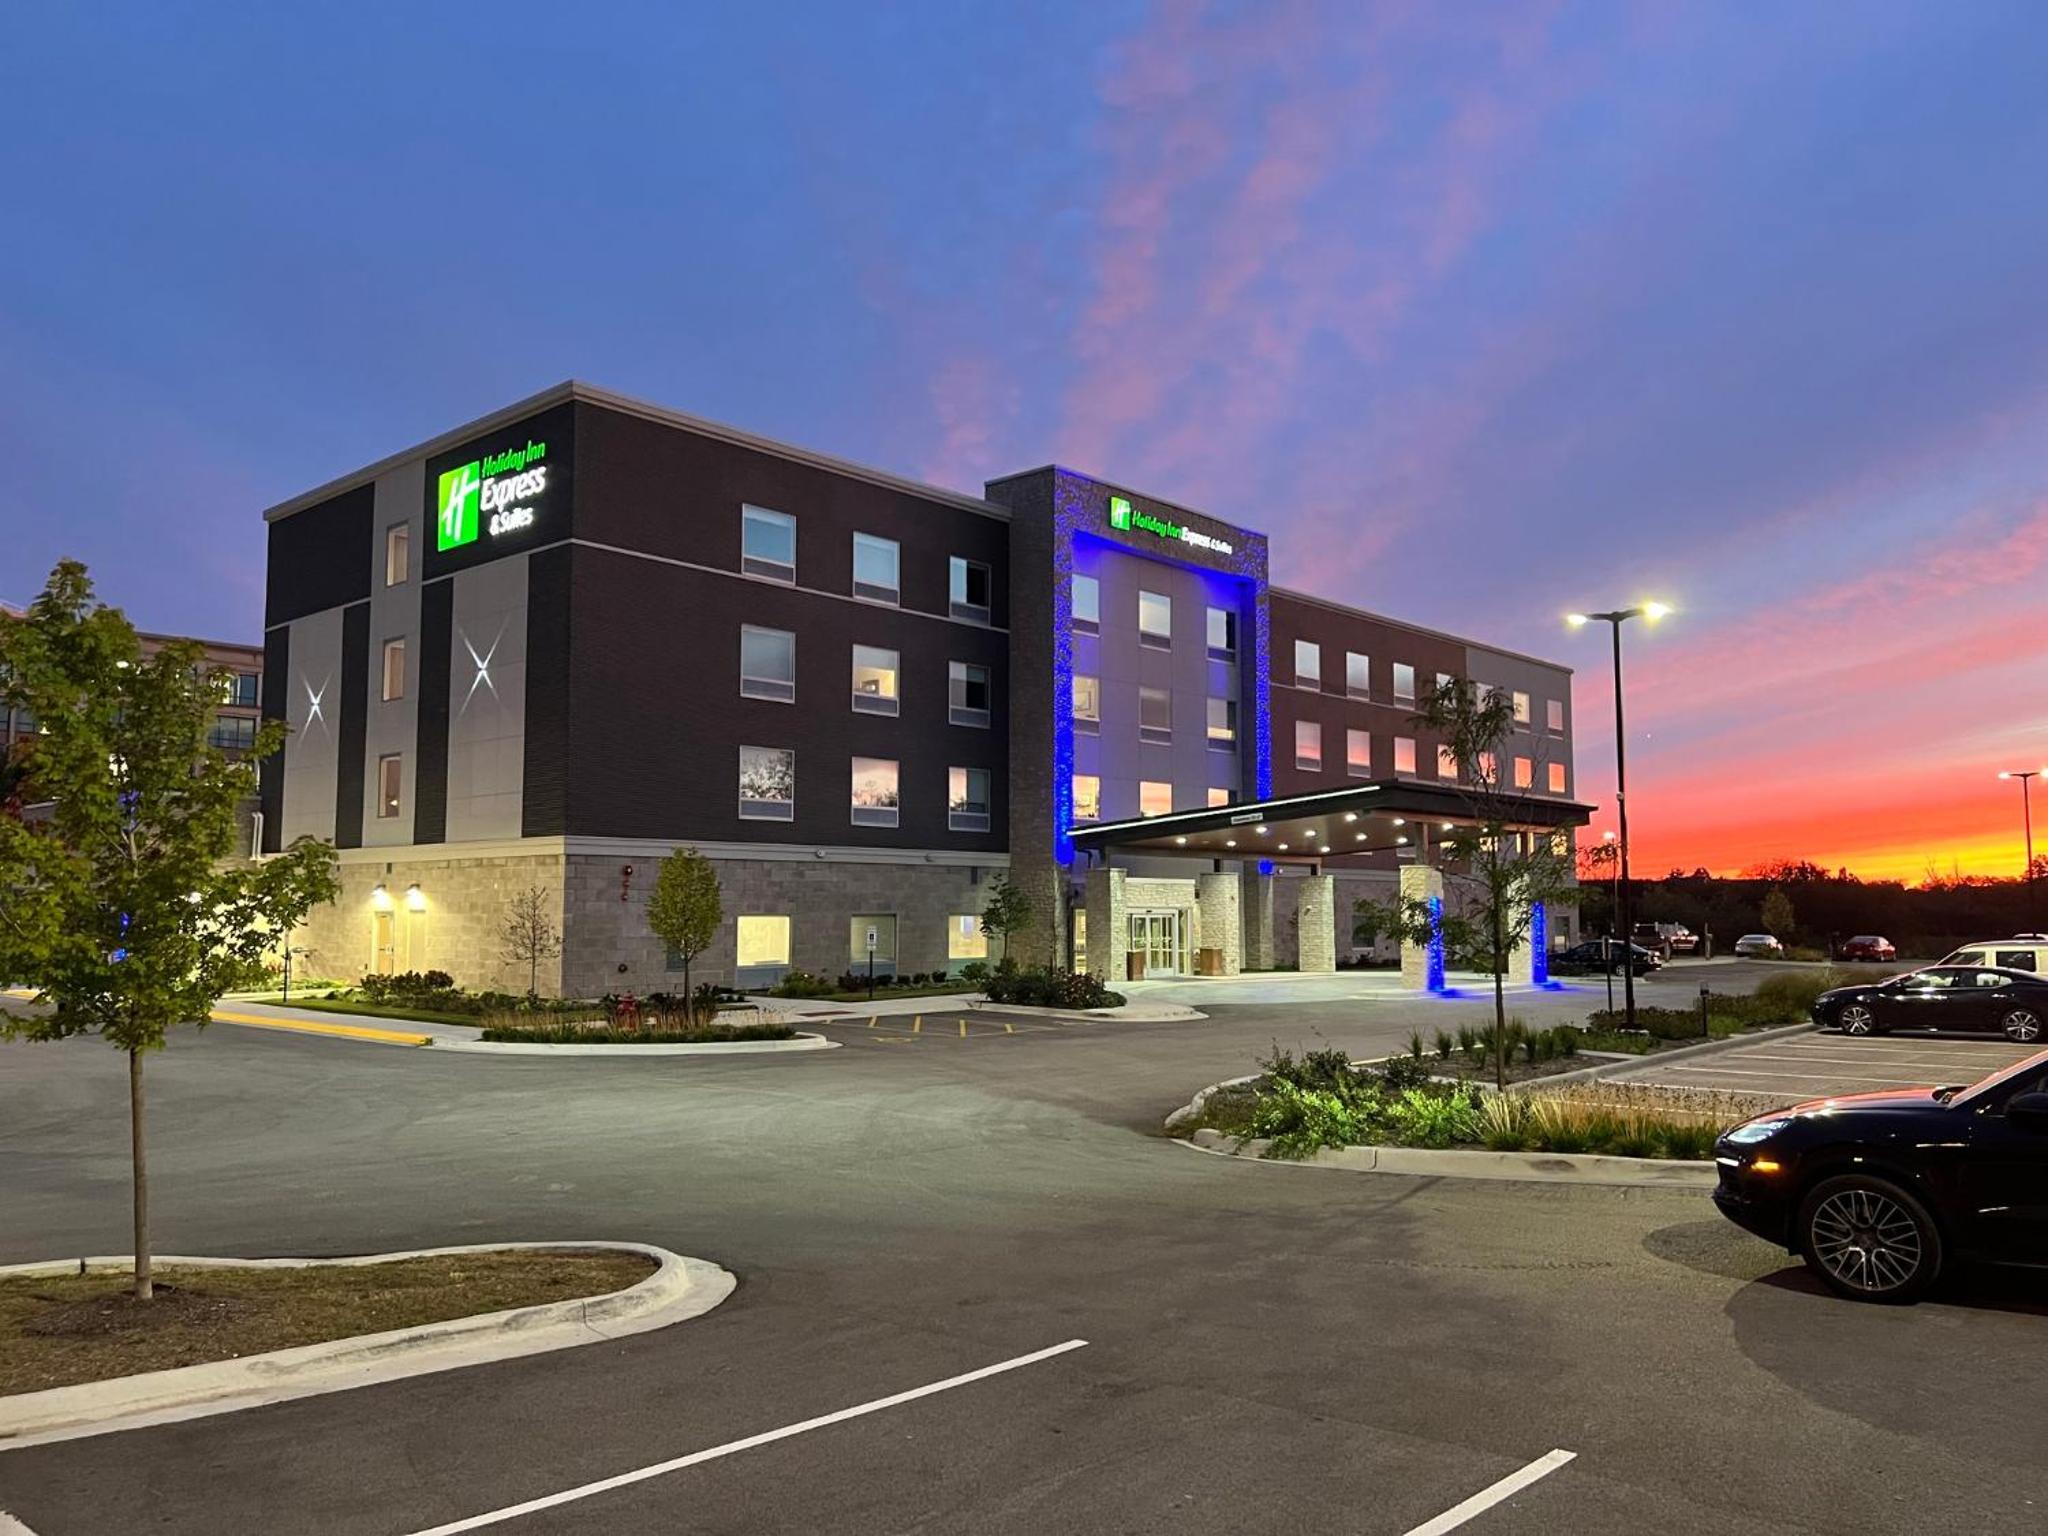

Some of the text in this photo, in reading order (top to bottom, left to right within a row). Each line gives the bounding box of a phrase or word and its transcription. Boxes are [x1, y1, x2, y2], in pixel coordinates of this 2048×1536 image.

[481, 440, 545, 478] Holiday Inn
[480, 466, 546, 513] Express
[1132, 510, 1167, 537] Holiday
